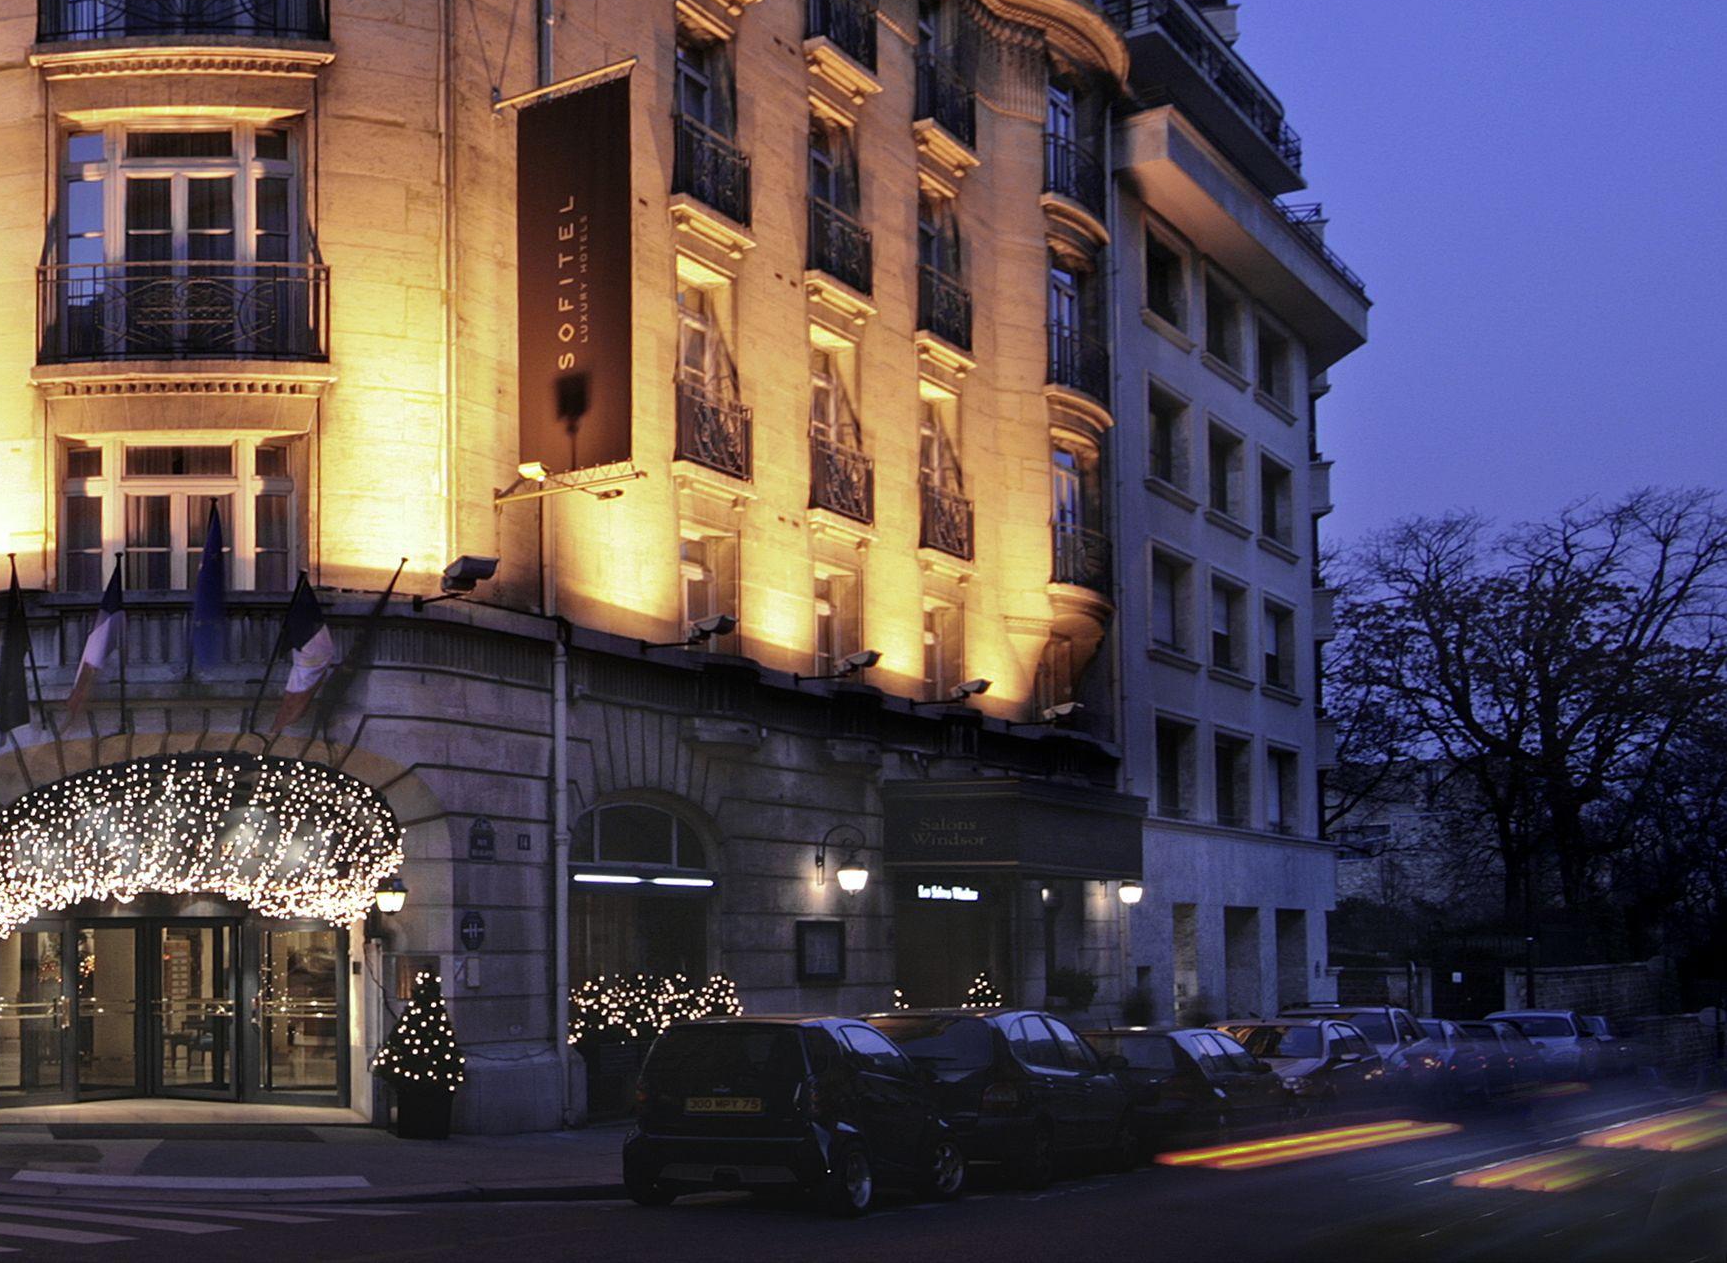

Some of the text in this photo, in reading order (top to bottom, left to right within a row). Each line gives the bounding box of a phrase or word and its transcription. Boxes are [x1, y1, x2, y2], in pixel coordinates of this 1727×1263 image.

[558, 195, 575, 370] SOFITEL
[579, 215, 589, 343] LUXURY HOTELS
[912, 832, 986, 846] Windsor
[920, 817, 978, 831] Salons
